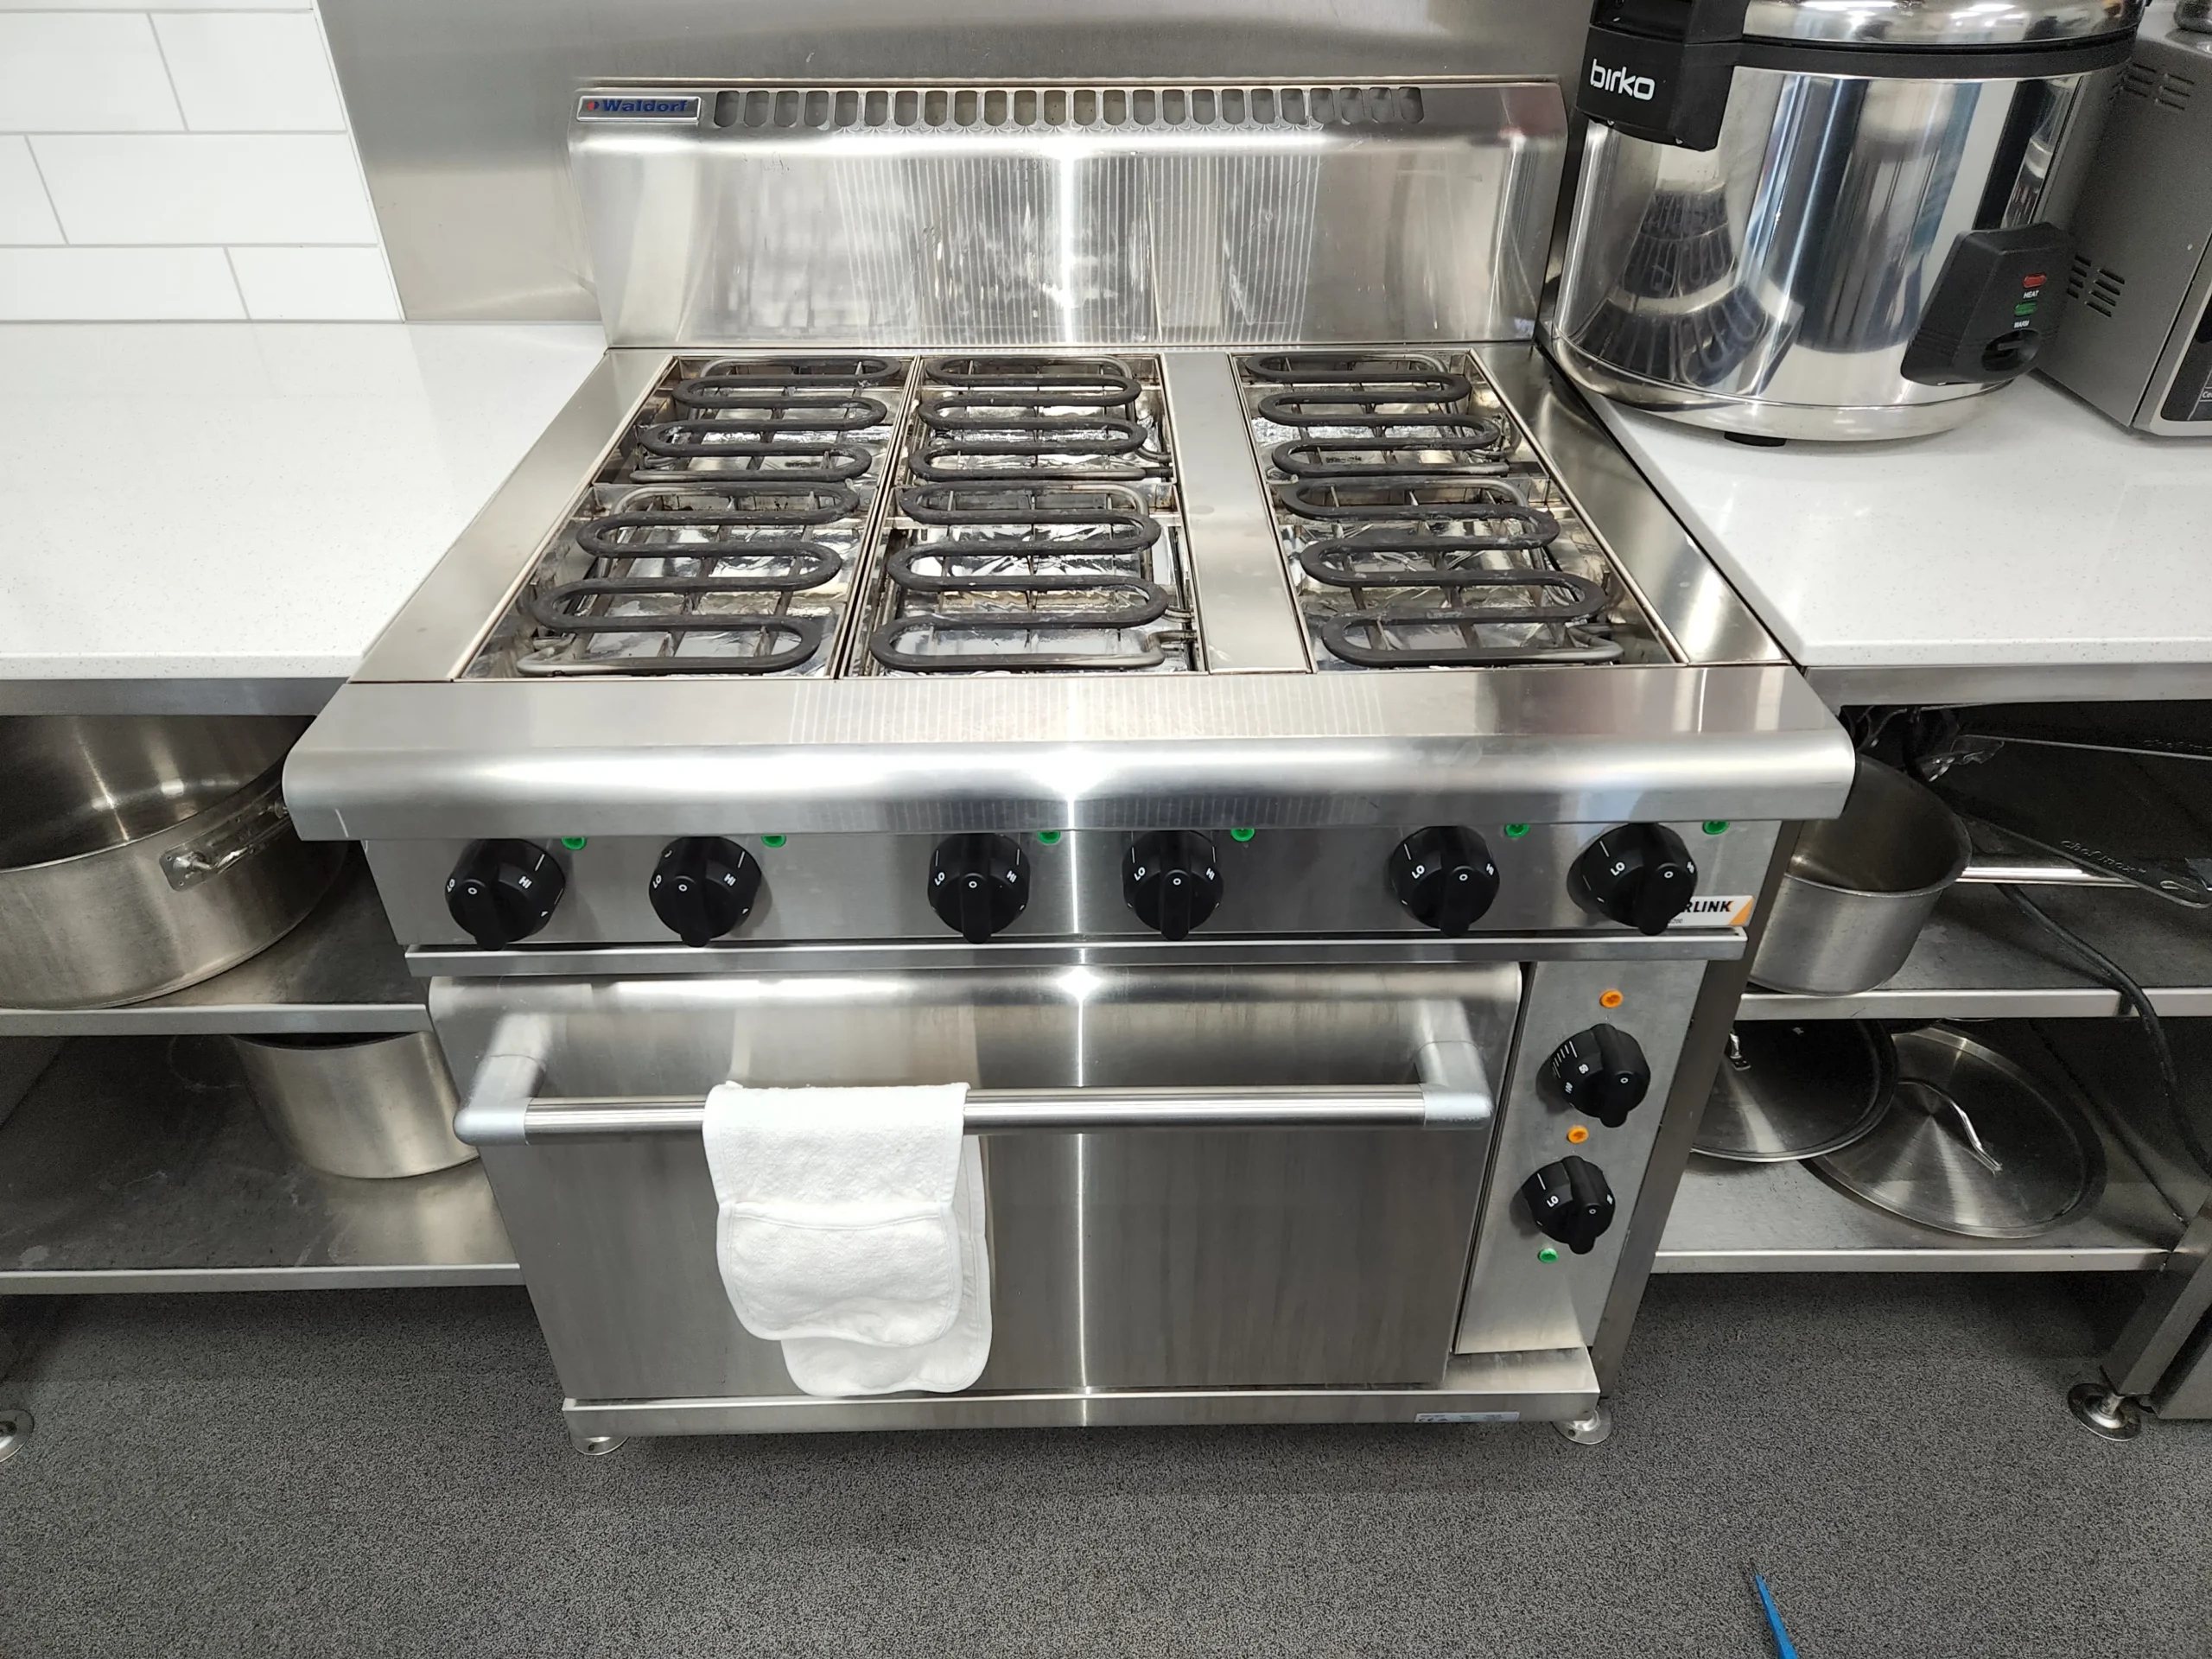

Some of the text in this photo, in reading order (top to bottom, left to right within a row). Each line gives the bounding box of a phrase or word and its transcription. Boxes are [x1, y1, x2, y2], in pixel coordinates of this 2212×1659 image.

[1590, 58, 1656, 101] birko
[602, 99, 688, 112] Waldorf
[2023, 290, 2039, 299] HEAT
[1134, 867, 1147, 881] LO
[1205, 868, 1216, 881] HI
[1411, 865, 1426, 880] LO
[1485, 862, 1494, 876] HI
[1610, 861, 1625, 877] LO
[518, 875, 533, 889] HI
[652, 874, 662, 889] LO
[723, 873, 737, 887] HI
[934, 871, 945, 887] LO
[1006, 870, 1017, 884] HI
[446, 878, 455, 893] LO
[1546, 1195, 1559, 1208] LO
